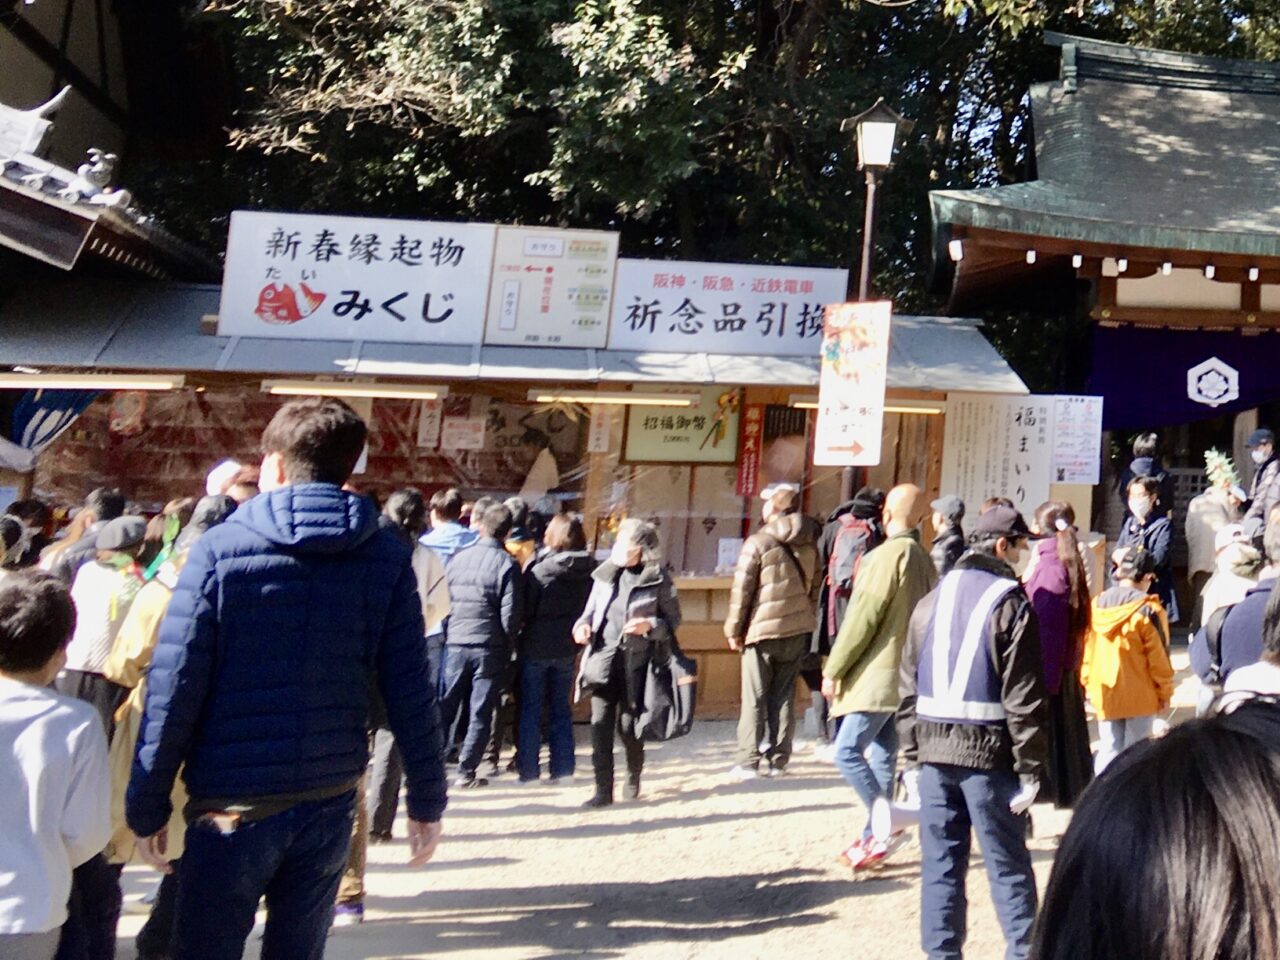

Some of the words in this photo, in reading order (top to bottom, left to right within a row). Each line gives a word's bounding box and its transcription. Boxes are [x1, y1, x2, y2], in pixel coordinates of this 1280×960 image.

[265, 227, 465, 267] 新春縁起物
[265, 266, 317, 281] たい
[653, 273, 815, 294] 阪神・阪急・近鉄電車
[332, 290, 454, 323] みくじ
[642, 415, 707, 431] 招福御幣
[1014, 406, 1037, 503] 福まいり
